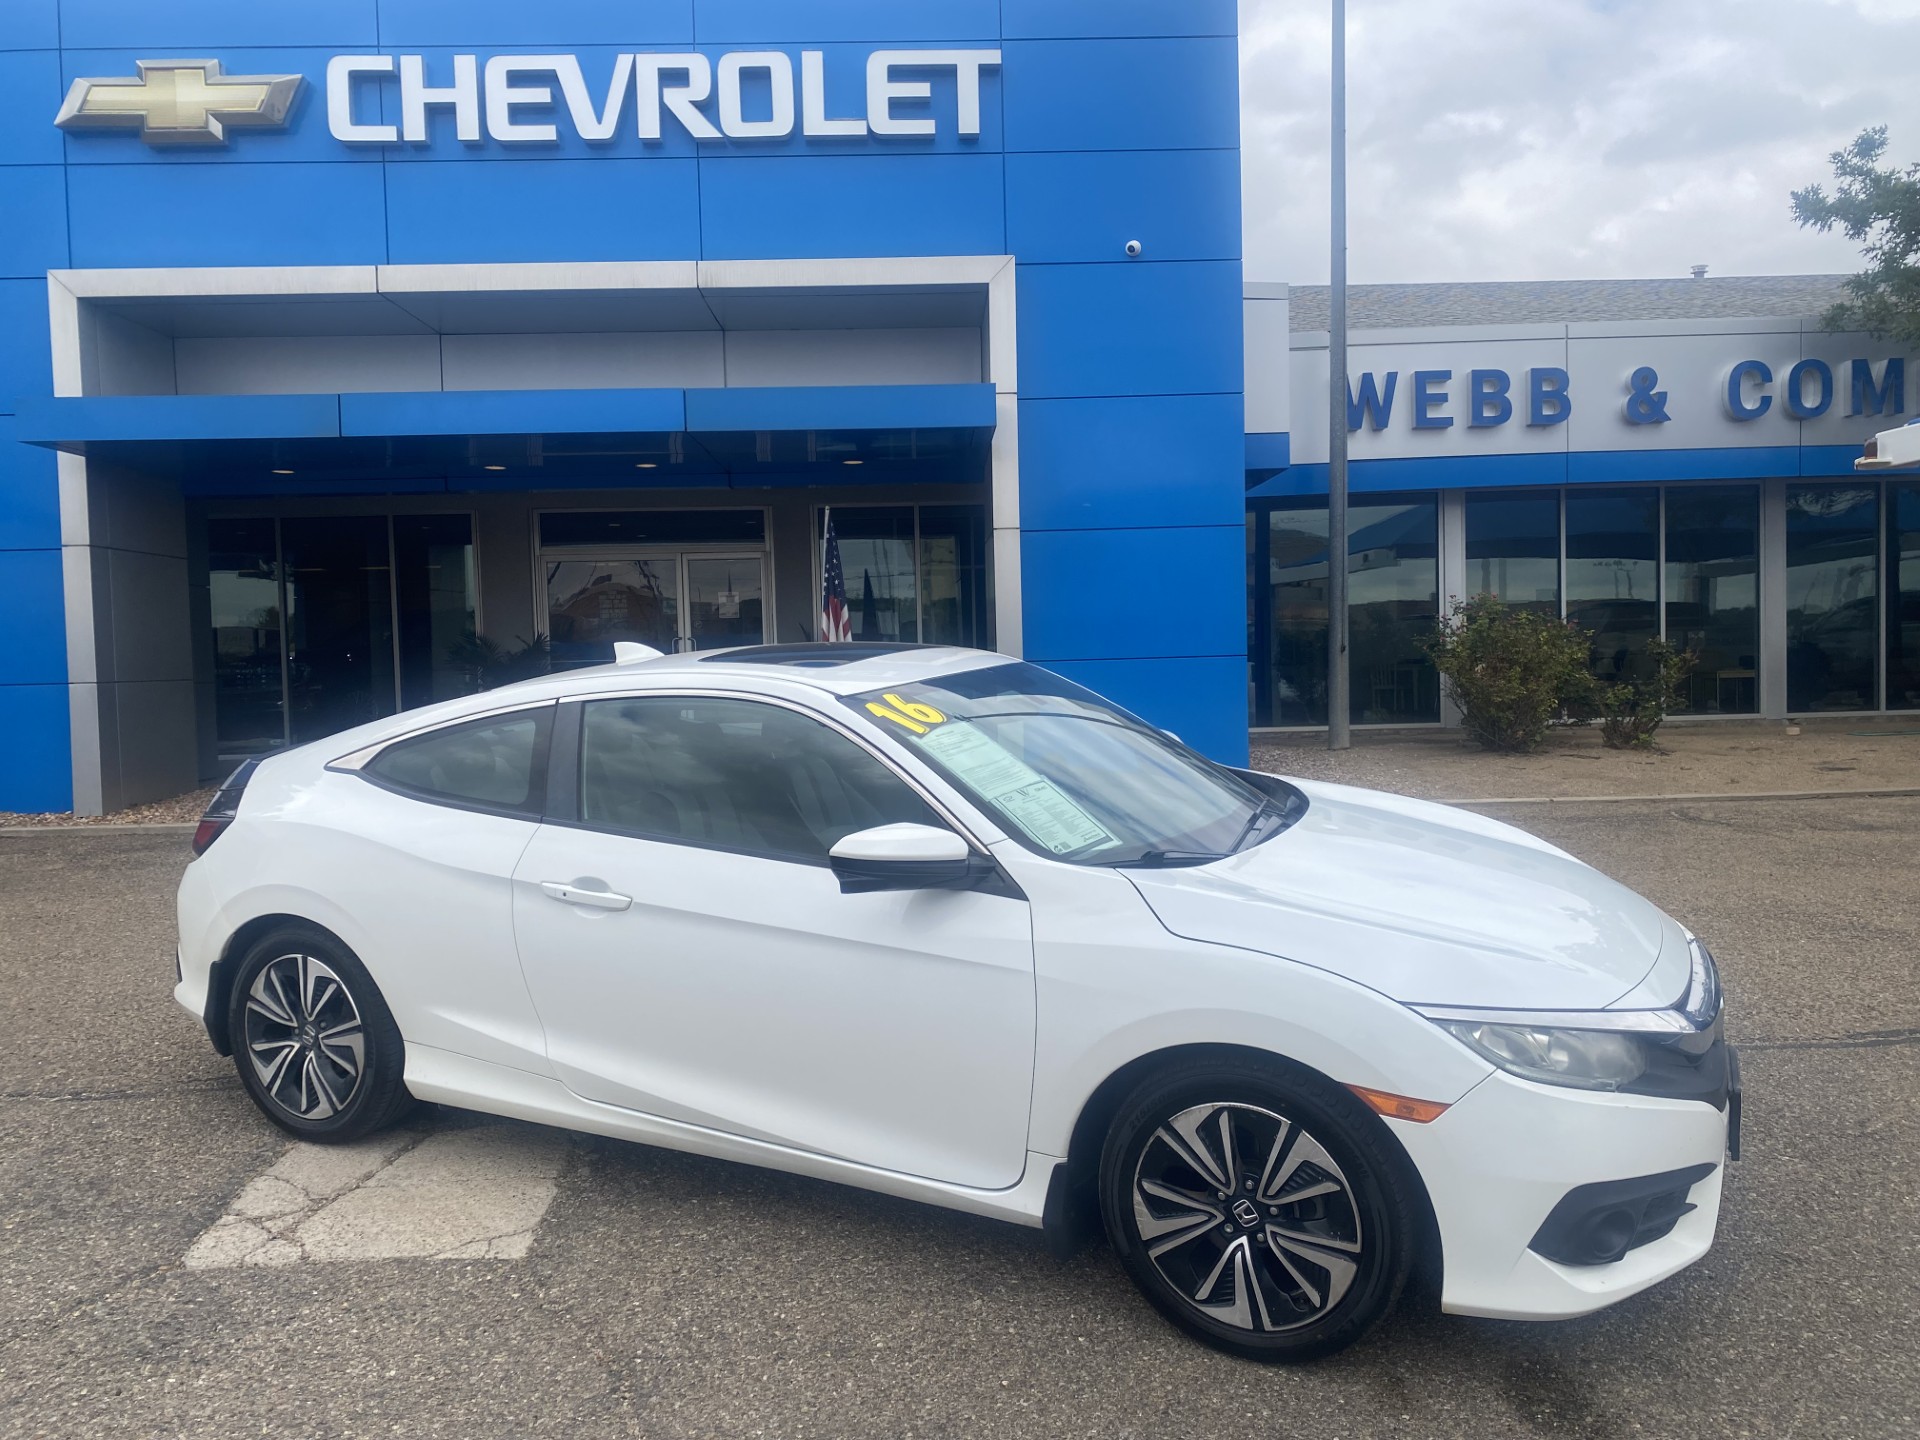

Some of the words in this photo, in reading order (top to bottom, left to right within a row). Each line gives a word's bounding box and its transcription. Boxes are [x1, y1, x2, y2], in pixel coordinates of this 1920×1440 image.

[327, 49, 1002, 143] CHEVROLET
[1346, 367, 1571, 432] WEBB
[1621, 366, 1672, 424] &
[864, 693, 947, 734] 16
